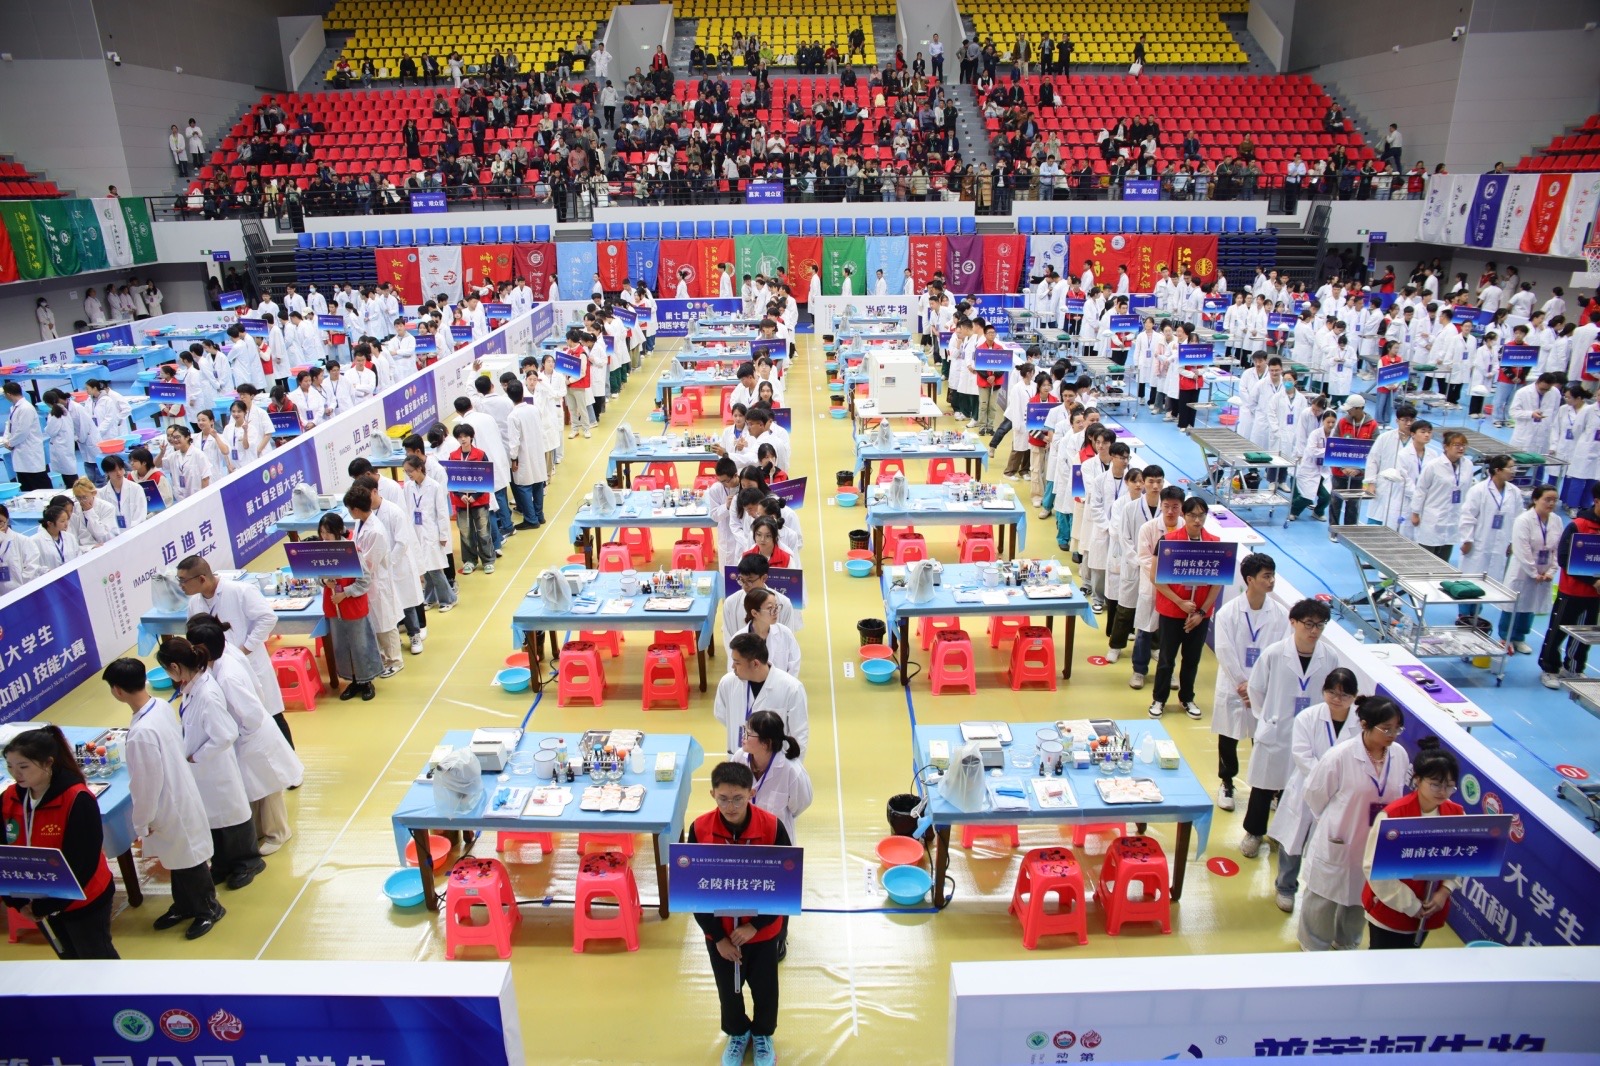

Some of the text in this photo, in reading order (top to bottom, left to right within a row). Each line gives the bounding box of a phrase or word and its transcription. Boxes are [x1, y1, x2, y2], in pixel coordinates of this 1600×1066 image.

[161, 519, 213, 566] 迈迪克
[310, 558, 339, 567] 宁夏大学
[1173, 559, 1220, 568] 湖南农业大学
[1172, 568, 1219, 576] 东方科技学院
[1401, 845, 1479, 859] 湖南农业大学
[697, 877, 776, 892] 金陵科技学院
